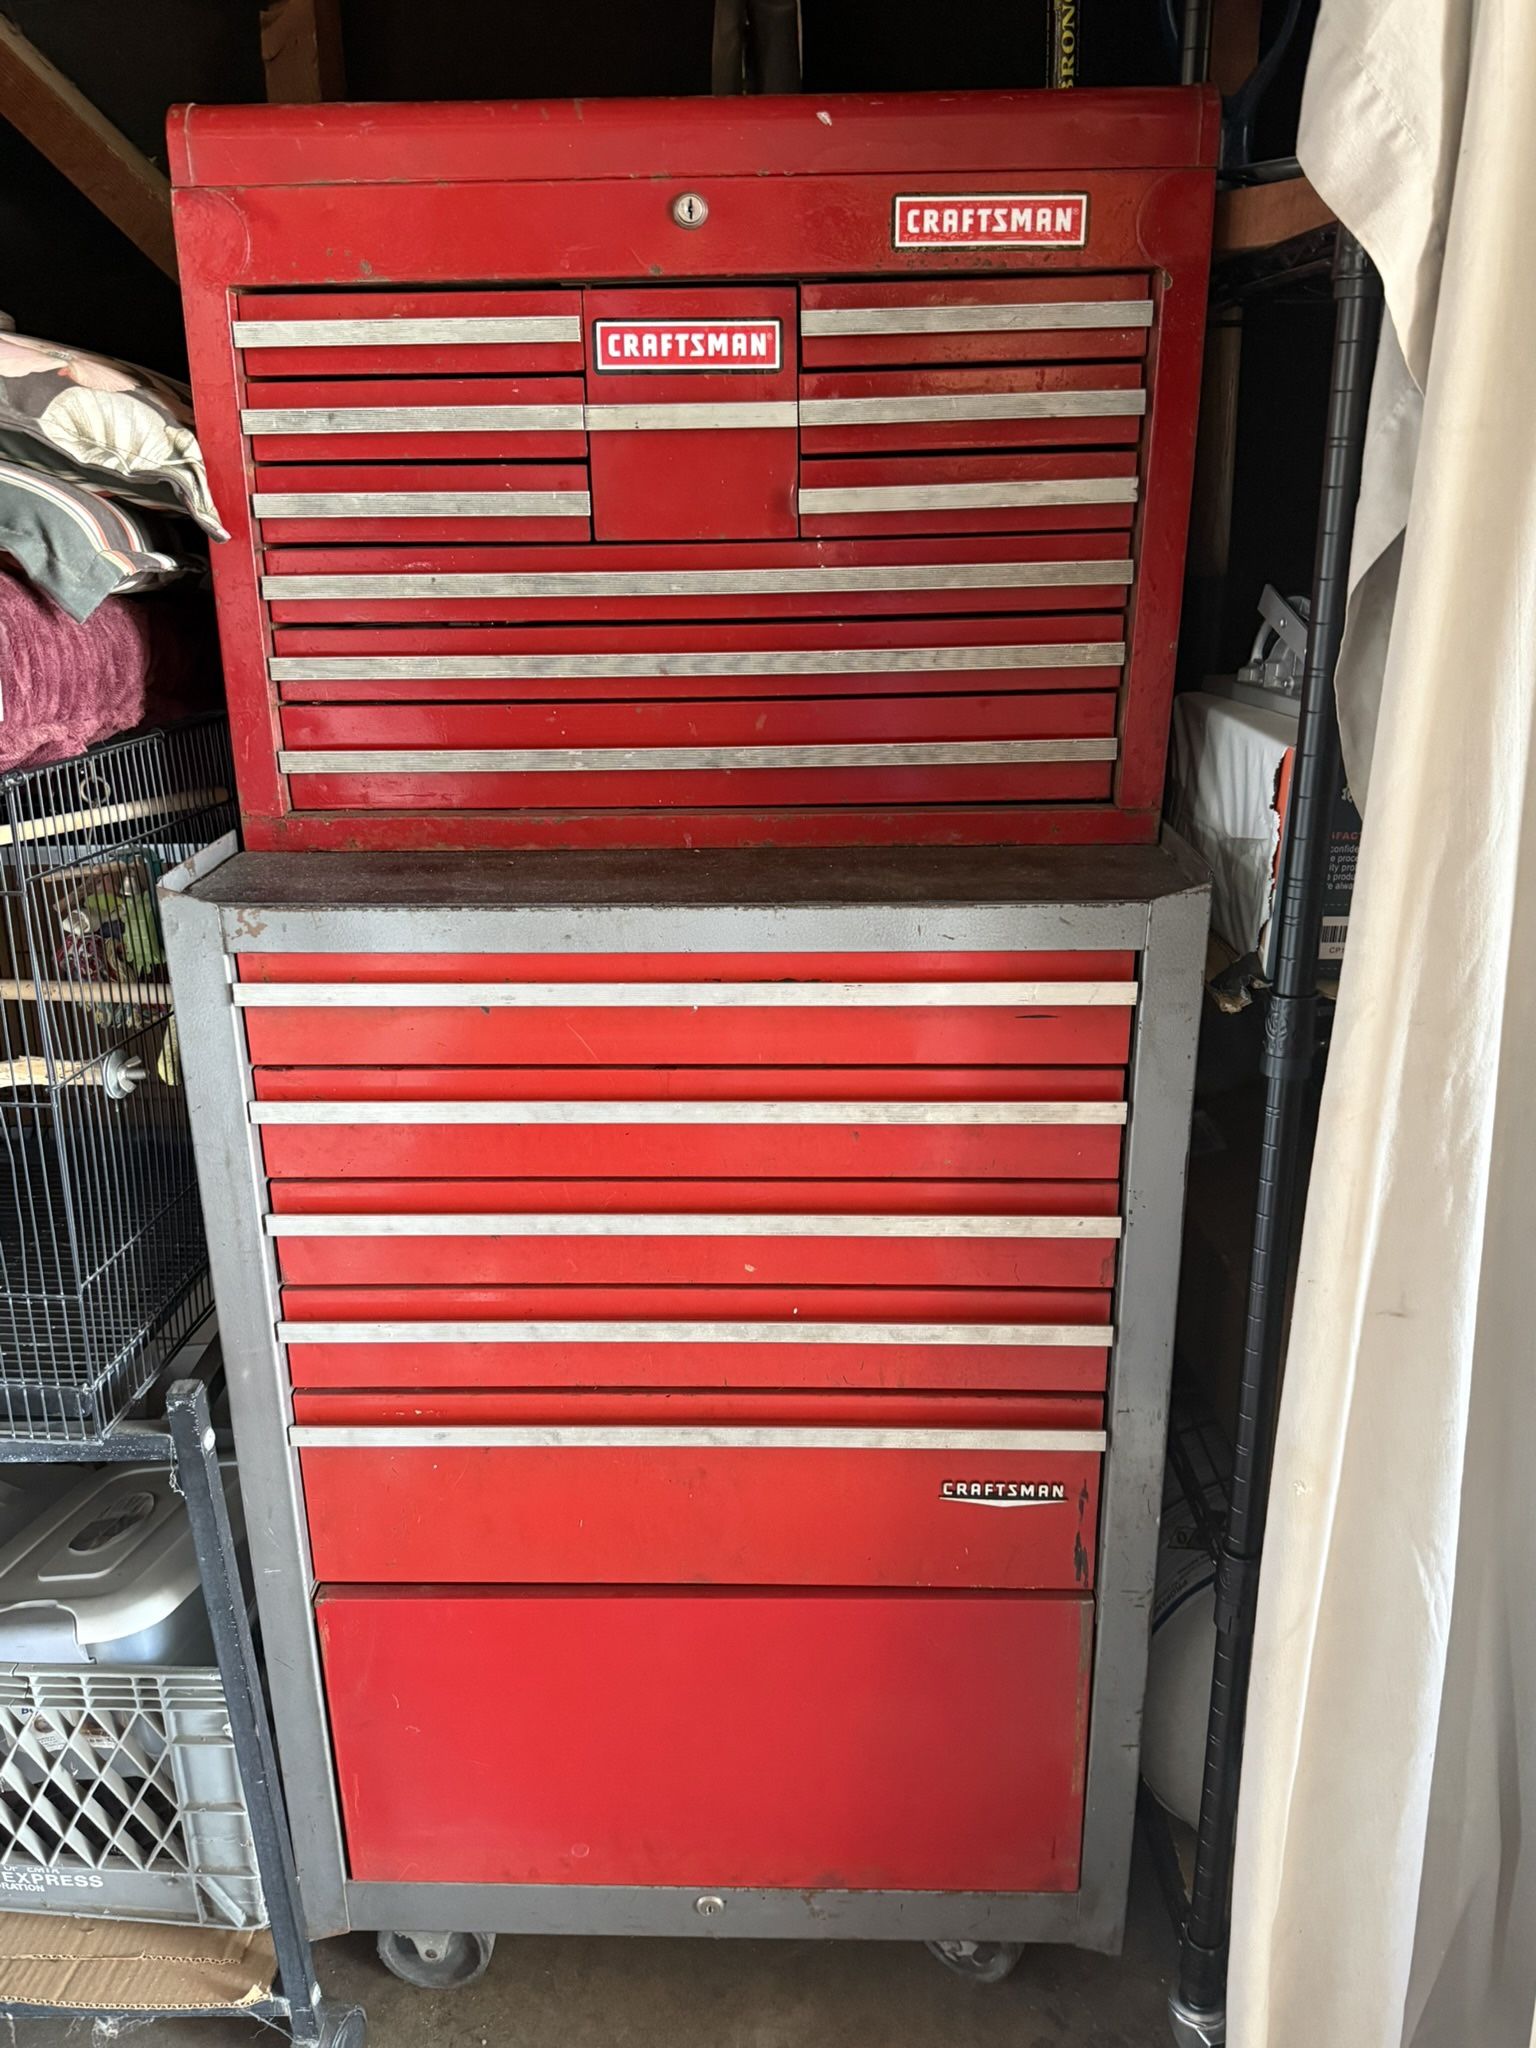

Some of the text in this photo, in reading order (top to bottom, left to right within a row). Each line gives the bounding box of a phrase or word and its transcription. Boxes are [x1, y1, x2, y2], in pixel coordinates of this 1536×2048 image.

[1060, 0, 1075, 88] RON
[907, 207, 1072, 233] CRAFTSMAN
[608, 333, 767, 357] CRAFTSMAN
[942, 1481, 1065, 1497] CRAFTSMAN
[0, 1881, 45, 1892] RATION
[2, 1871, 104, 1888] EXPRESS
